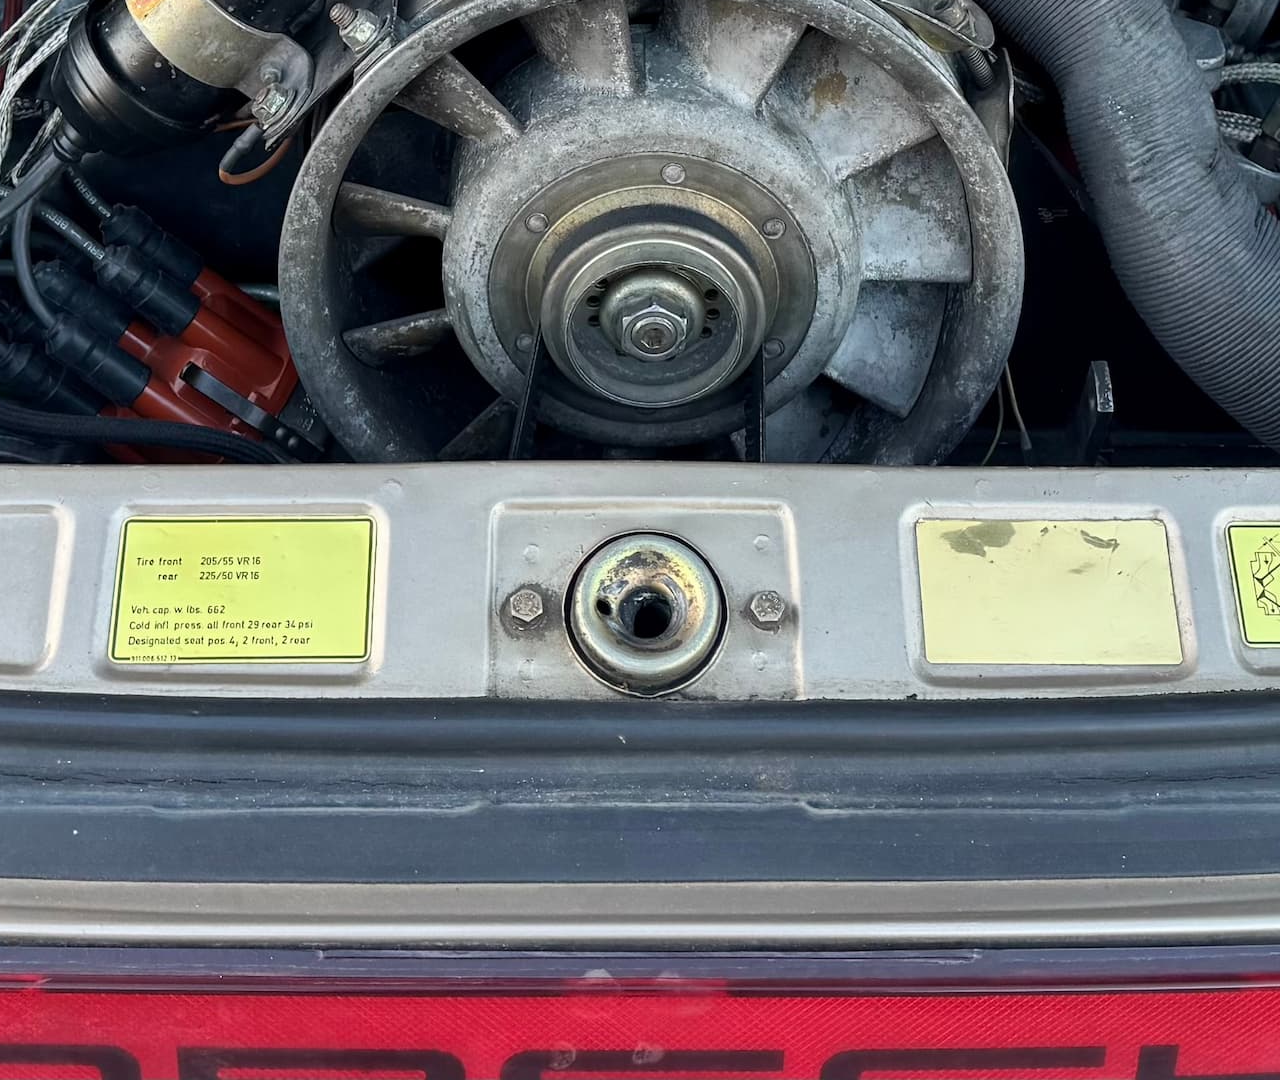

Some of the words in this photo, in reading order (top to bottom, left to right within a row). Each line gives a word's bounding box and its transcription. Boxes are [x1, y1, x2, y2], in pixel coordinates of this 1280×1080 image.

[136, 557, 155, 566] Tire
[158, 557, 183, 566] front
[200, 556, 234, 566] 205/55
[158, 573, 179, 581] rear
[199, 571, 233, 580] 225/50
[207, 605, 226, 614] 662
[129, 621, 150, 630] Cold
[207, 620, 219, 629] all
[222, 620, 245, 629] front
[247, 620, 260, 629] 29
[298, 620, 313, 630] psi
[128, 636, 181, 648] Designated
[184, 637, 204, 645] seat
[242, 636, 248, 645] 2
[252, 636, 278, 646] front,
[282, 635, 288, 645] 2
[289, 637, 311, 645] rear
